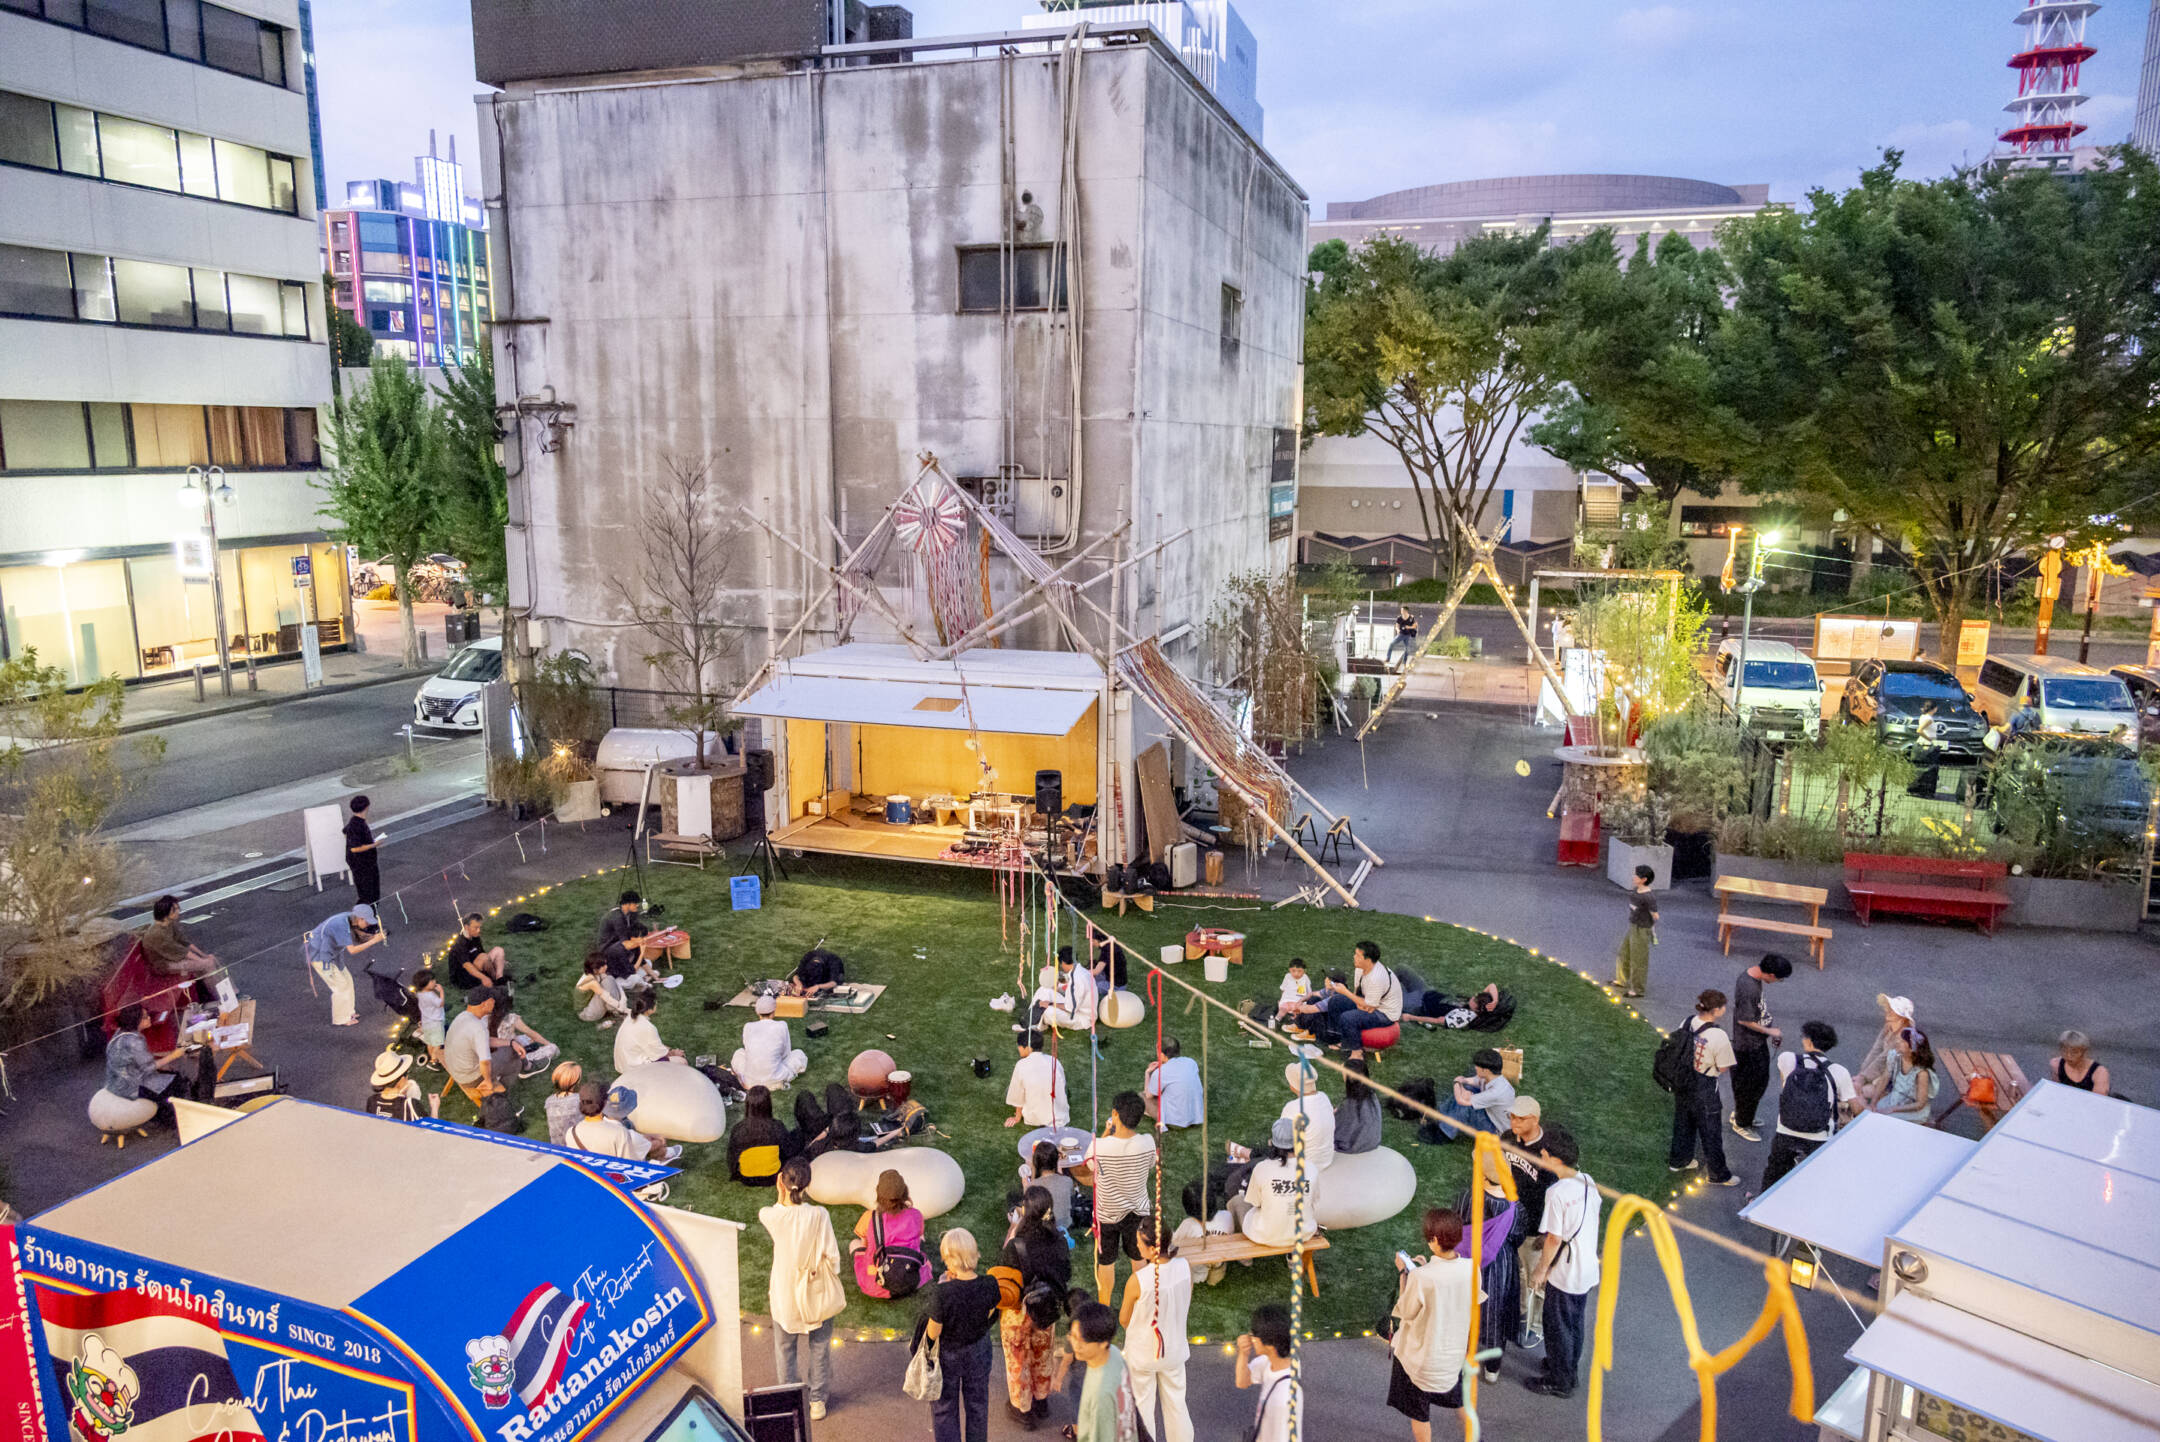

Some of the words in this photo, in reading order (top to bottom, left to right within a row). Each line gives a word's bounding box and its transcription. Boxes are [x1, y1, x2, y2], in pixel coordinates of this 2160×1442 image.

[24, 1236, 128, 1290] ร้านอาหาร
[133, 1269, 280, 1333] รัตนโกสินทร์
[564, 1319, 595, 1357] Cafe
[602, 1240, 654, 1309] Restaurant
[582, 1264, 608, 1296] Thai
[288, 1323, 336, 1351] SINCE
[344, 1340, 381, 1364] 2018
[497, 1286, 686, 1442] Rattanakosin
[604, 1318, 676, 1398] รัตนโกสินทร์
[266, 1358, 317, 1413] Thai
